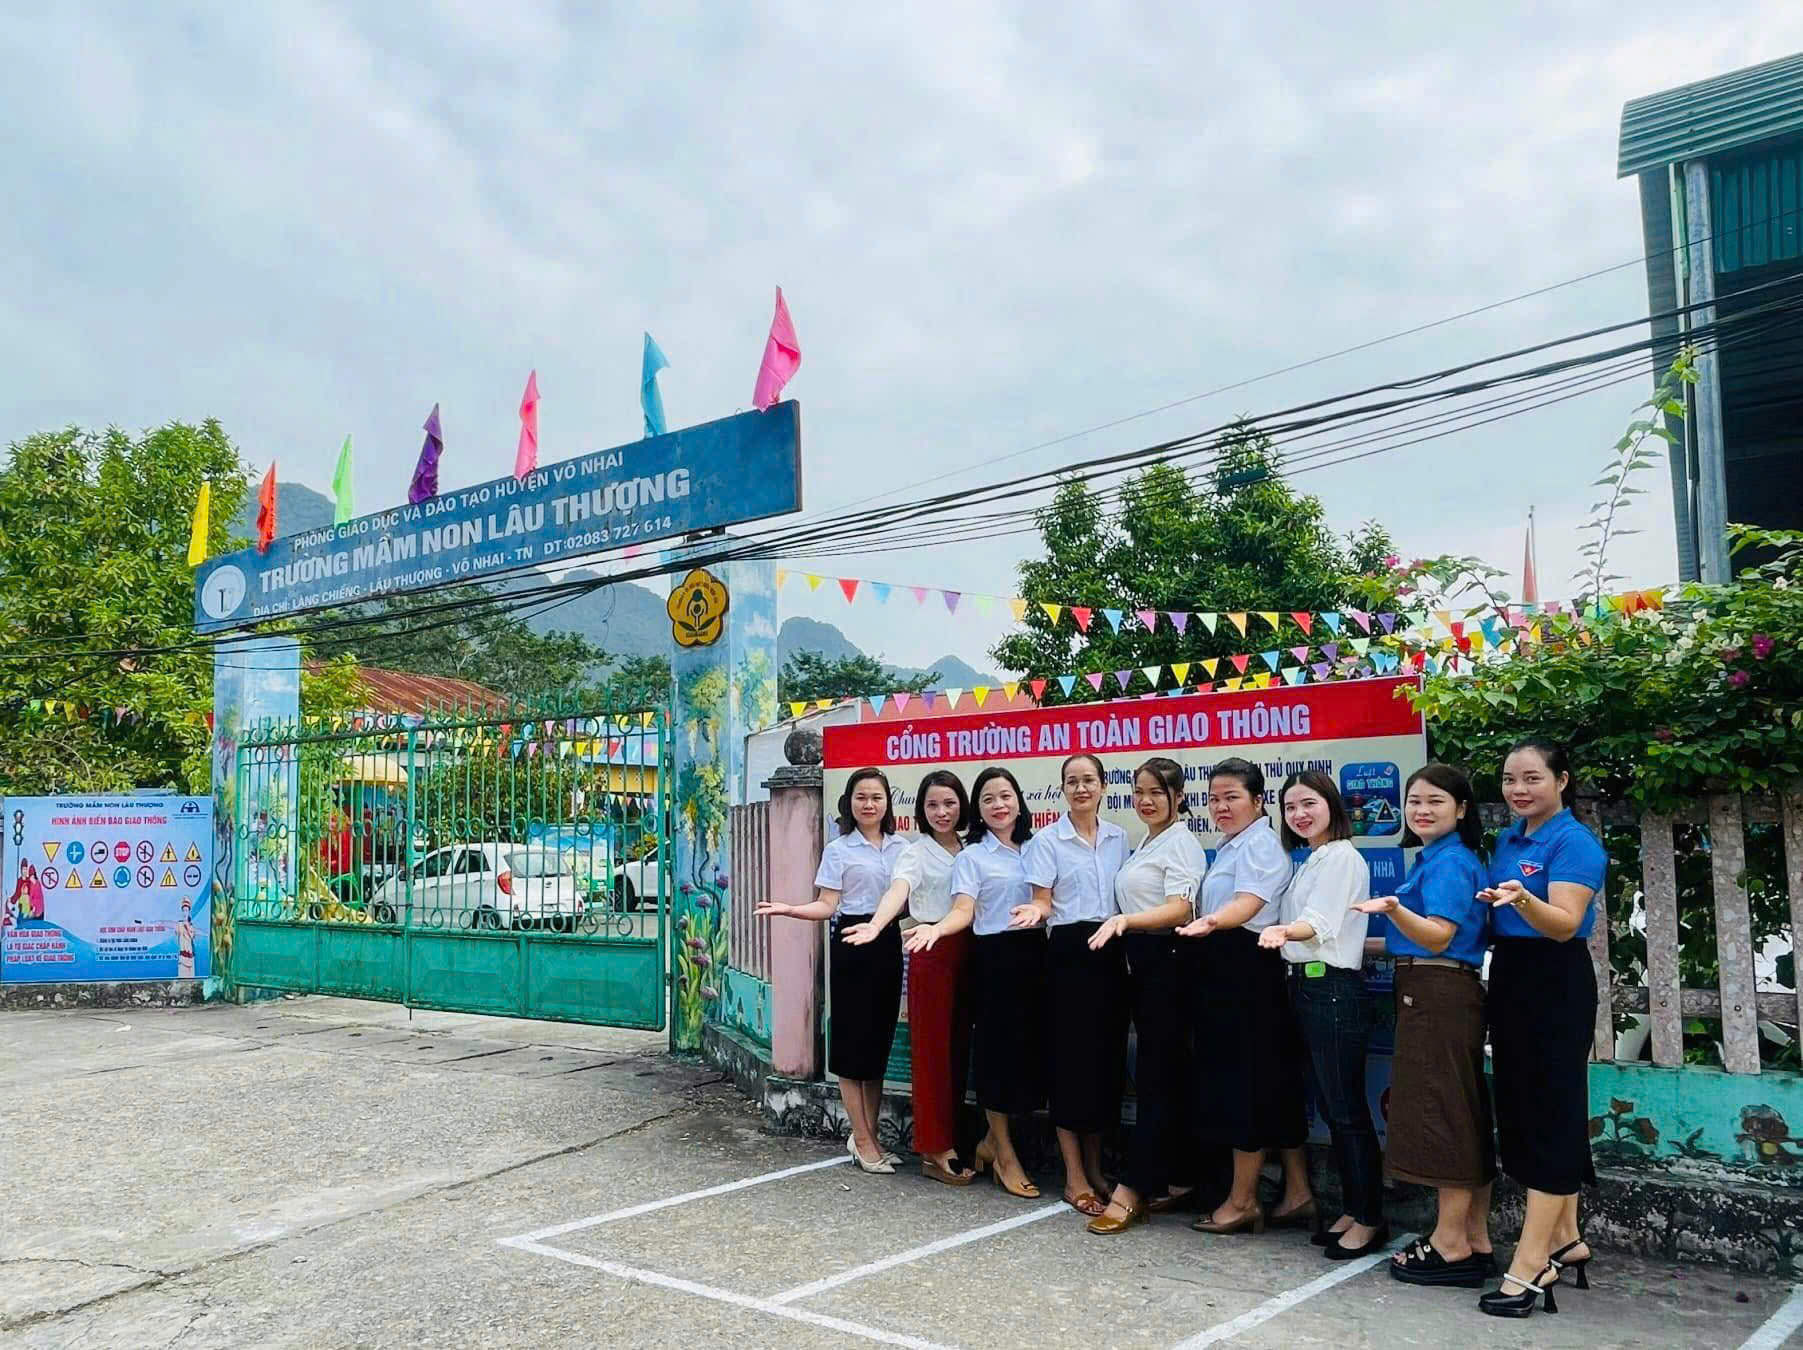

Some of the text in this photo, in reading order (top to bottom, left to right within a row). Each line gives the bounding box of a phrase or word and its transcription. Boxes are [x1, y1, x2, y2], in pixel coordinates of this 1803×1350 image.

[258, 468, 690, 593] TRƯỜNG MẦM NON LÂU THƯỢNG
[294, 451, 623, 551] PHÒNG GIÁO DỤC VÀ ĐÀO TẠO HUYỆN VÕ NHAI
[393, 566, 443, 587] THƯỢNG
[451, 557, 470, 575] VÕ
[473, 553, 504, 570] NHAI
[515, 547, 533, 561] TN
[614, 523, 640, 540] 727
[644, 515, 672, 534] 614
[886, 701, 1311, 761] CỔNG TRƯỜNG AN TOÀN GIAO THÔNG
[1104, 767, 1131, 785] RƯỜNG
[1264, 757, 1283, 778] THỦ
[1107, 792, 1121, 812] ĐỘI
[1373, 857, 1396, 878] NHÀ
